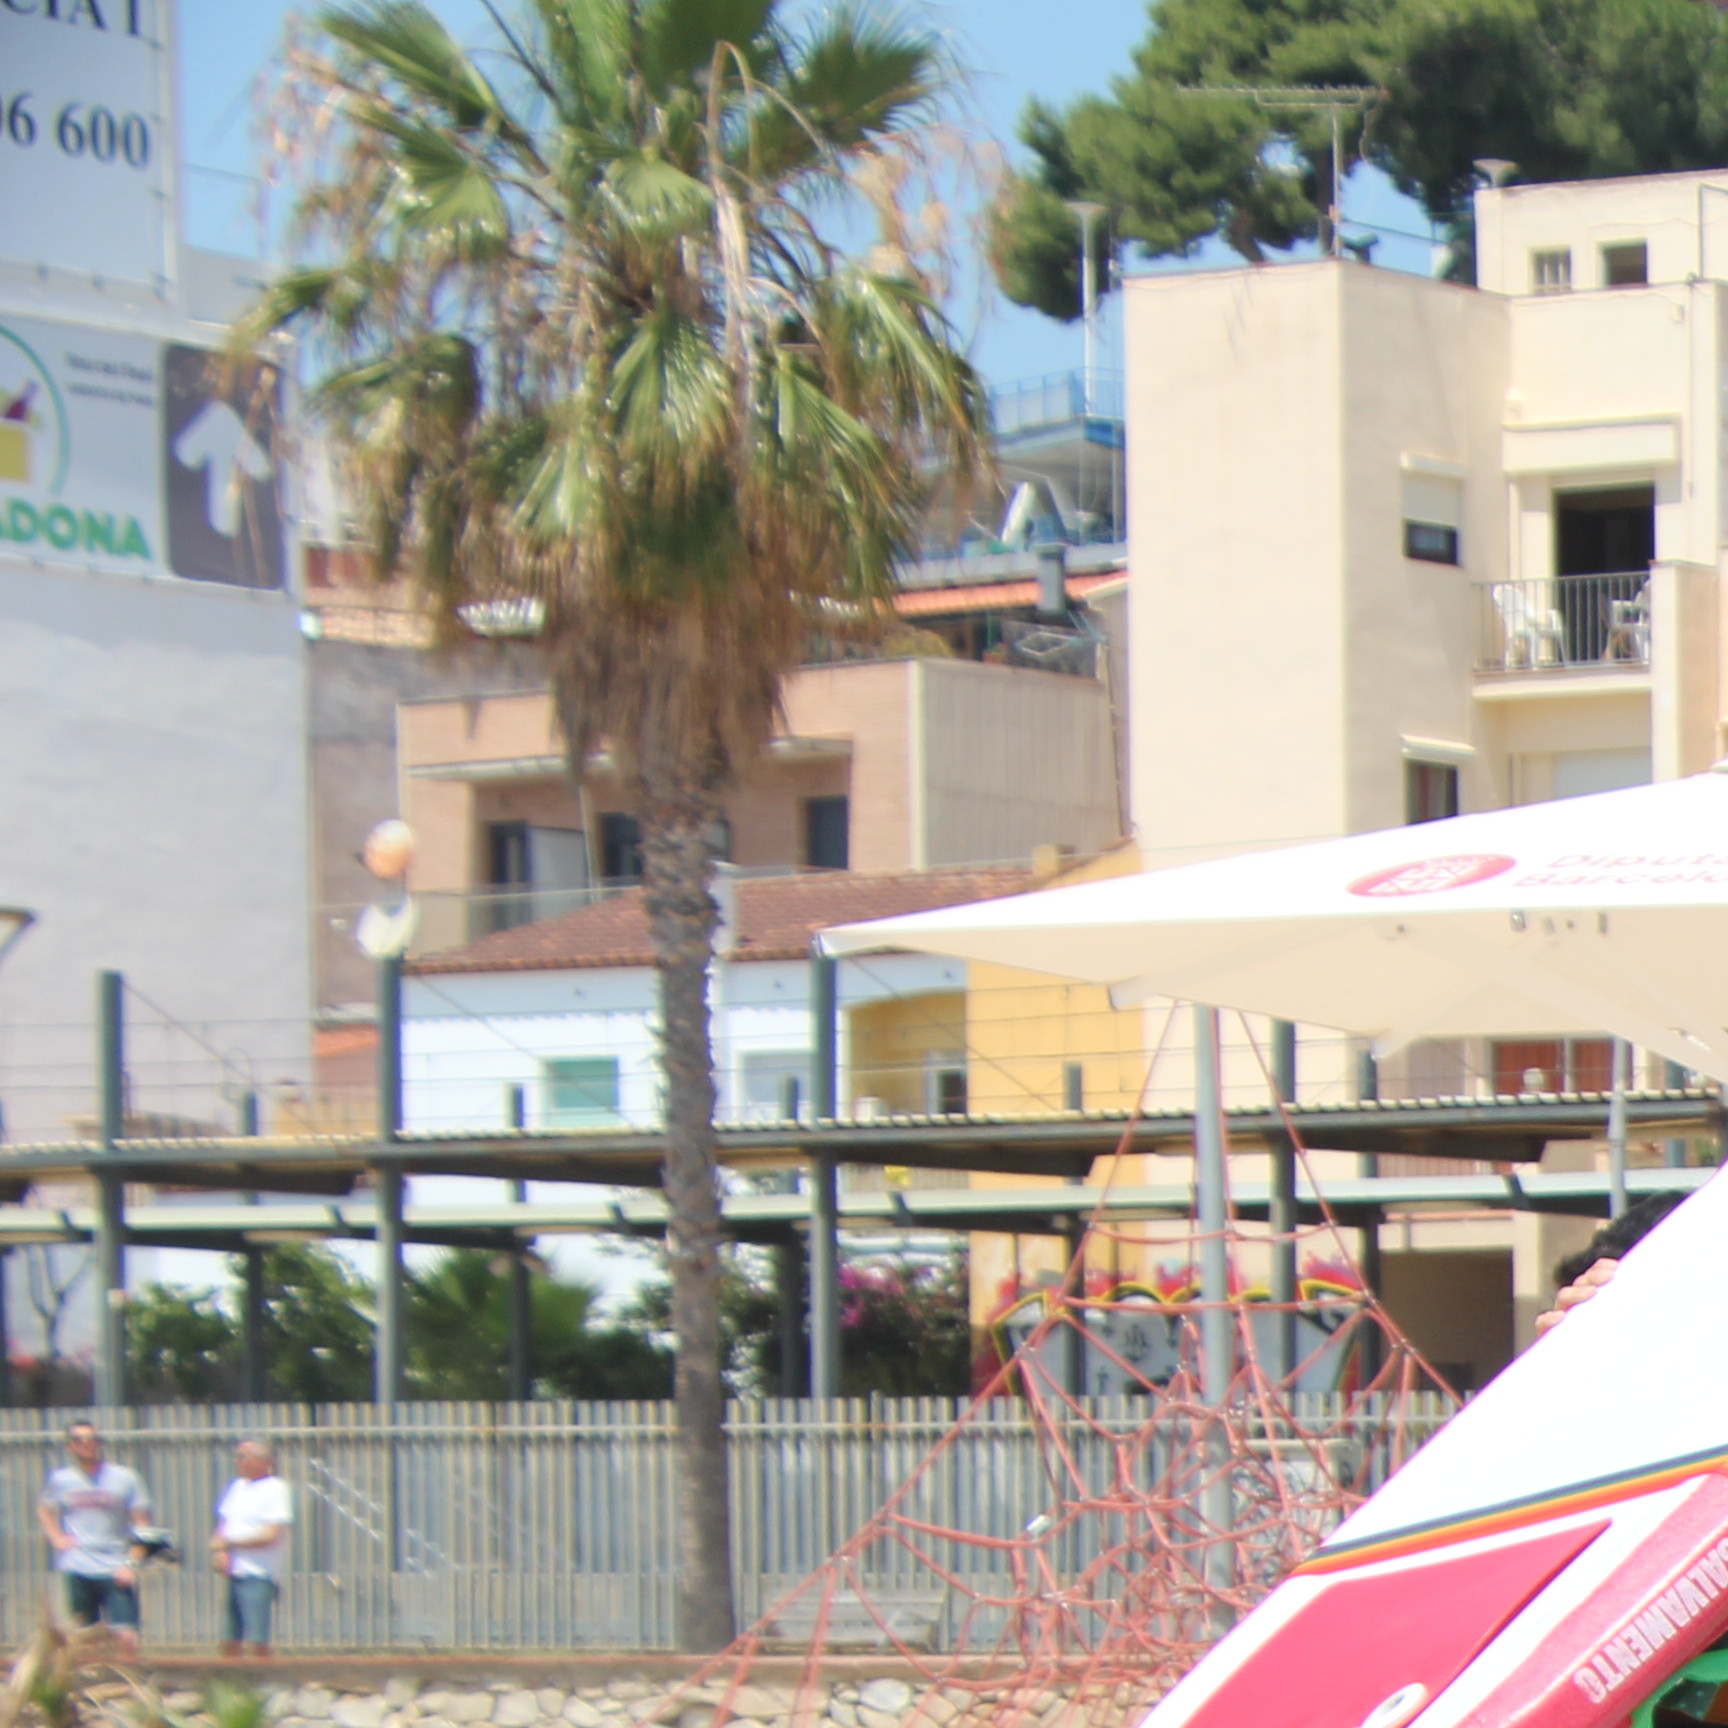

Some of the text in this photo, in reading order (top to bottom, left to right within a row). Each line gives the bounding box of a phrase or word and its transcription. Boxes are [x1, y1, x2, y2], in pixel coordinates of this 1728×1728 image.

[0, 91, 150, 170] 6 600
[0, 497, 151, 561] DONA
